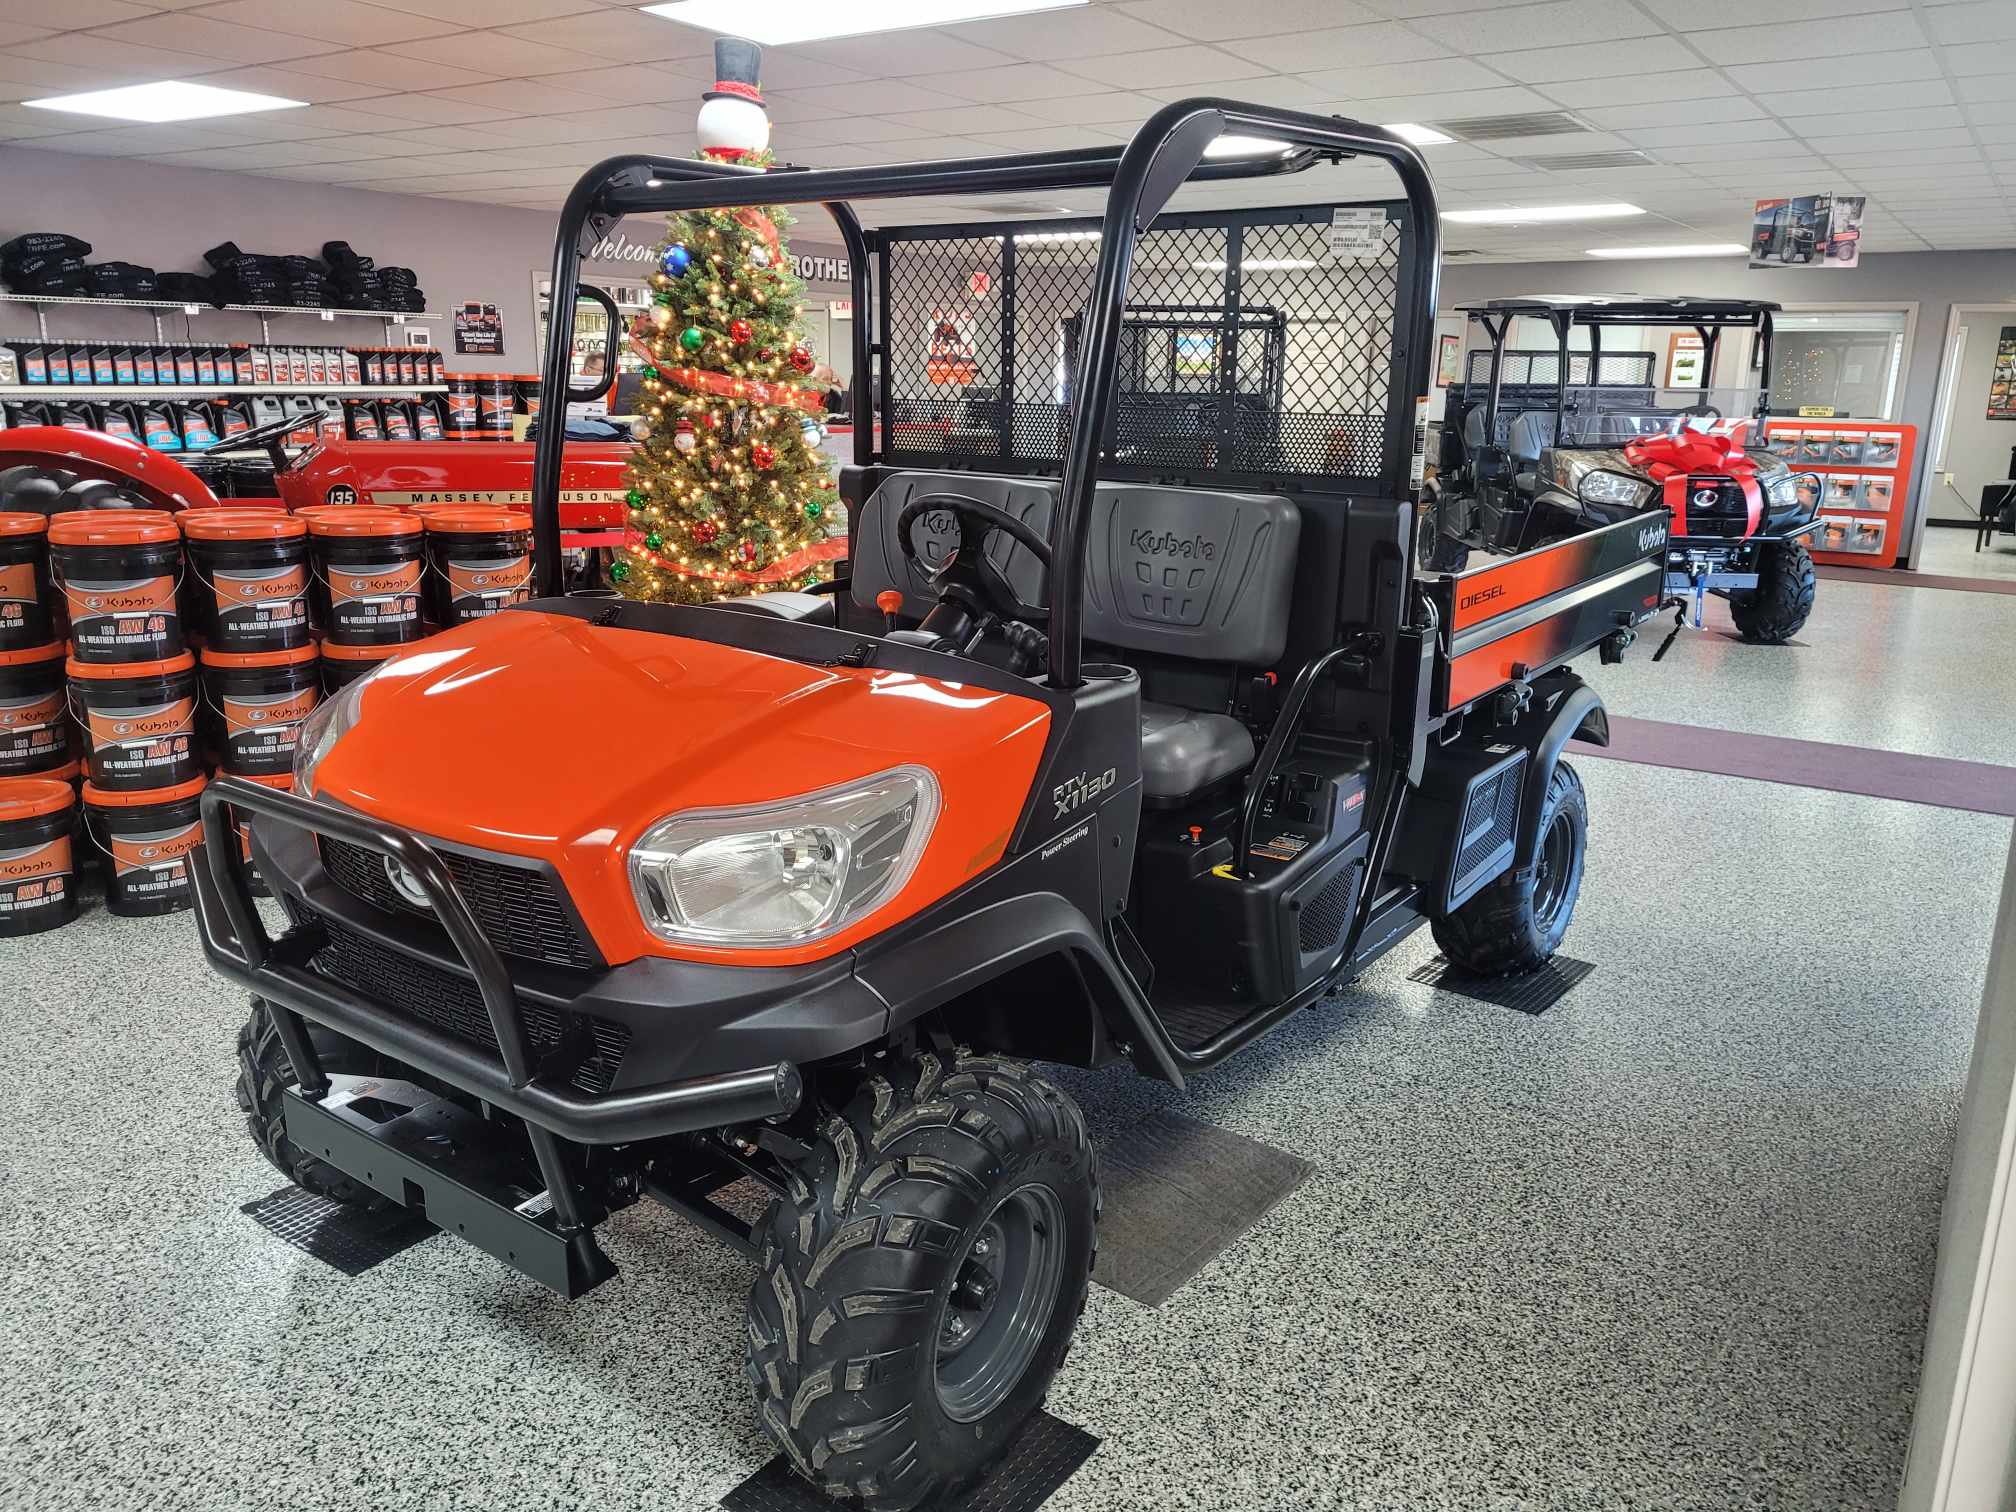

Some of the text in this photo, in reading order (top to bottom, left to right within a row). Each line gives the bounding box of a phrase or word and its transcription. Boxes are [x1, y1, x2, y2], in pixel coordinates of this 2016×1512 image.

[330, 491, 354, 505] 135
[411, 492, 613, 503] MASSEY FEUSON
[1130, 528, 1216, 561] Kubota
[1638, 523, 1666, 552] Kubota
[262, 583, 299, 594] Kubota
[370, 579, 409, 590] Kubota
[107, 596, 154, 608] Kubota
[1460, 584, 1507, 610] DIESEL
[147, 616, 166, 632] 46
[269, 706, 308, 719] Kubota
[136, 719, 179, 732] Kubota
[130, 750, 144, 759] ISO
[1053, 771, 1087, 801] RTV
[1053, 767, 1116, 821] X1130
[161, 839, 199, 854] Kubota
[1041, 826, 1089, 860] Power Steering
[4, 860, 52, 875] Kubota
[169, 877, 188, 888] HYDRA
[17, 881, 44, 901] AW
